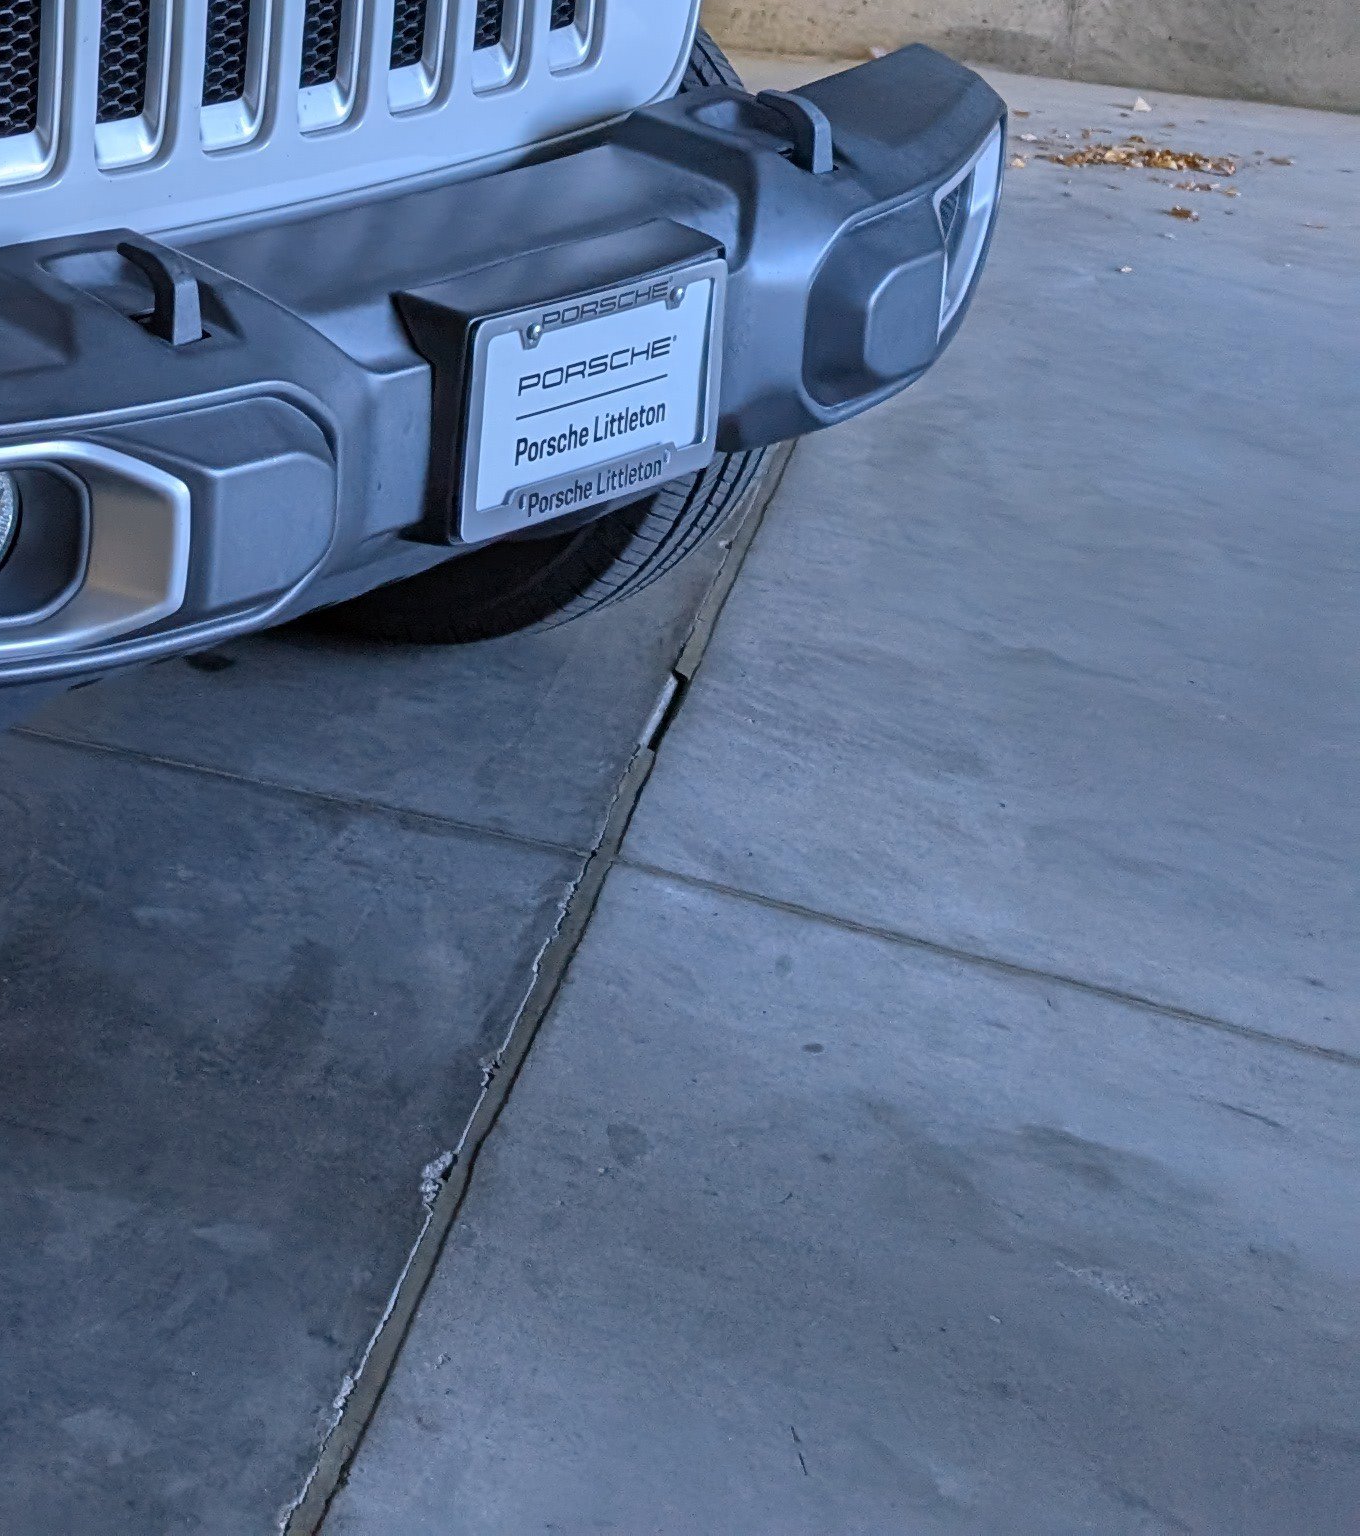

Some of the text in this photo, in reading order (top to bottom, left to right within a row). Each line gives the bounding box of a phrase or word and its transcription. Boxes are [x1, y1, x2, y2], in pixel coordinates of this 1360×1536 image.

[541, 279, 671, 327] PORSCHE
[517, 336, 671, 396] PORSCHE
[514, 402, 667, 466] Porsche Littleton
[527, 458, 662, 517] Porsche Littleton
